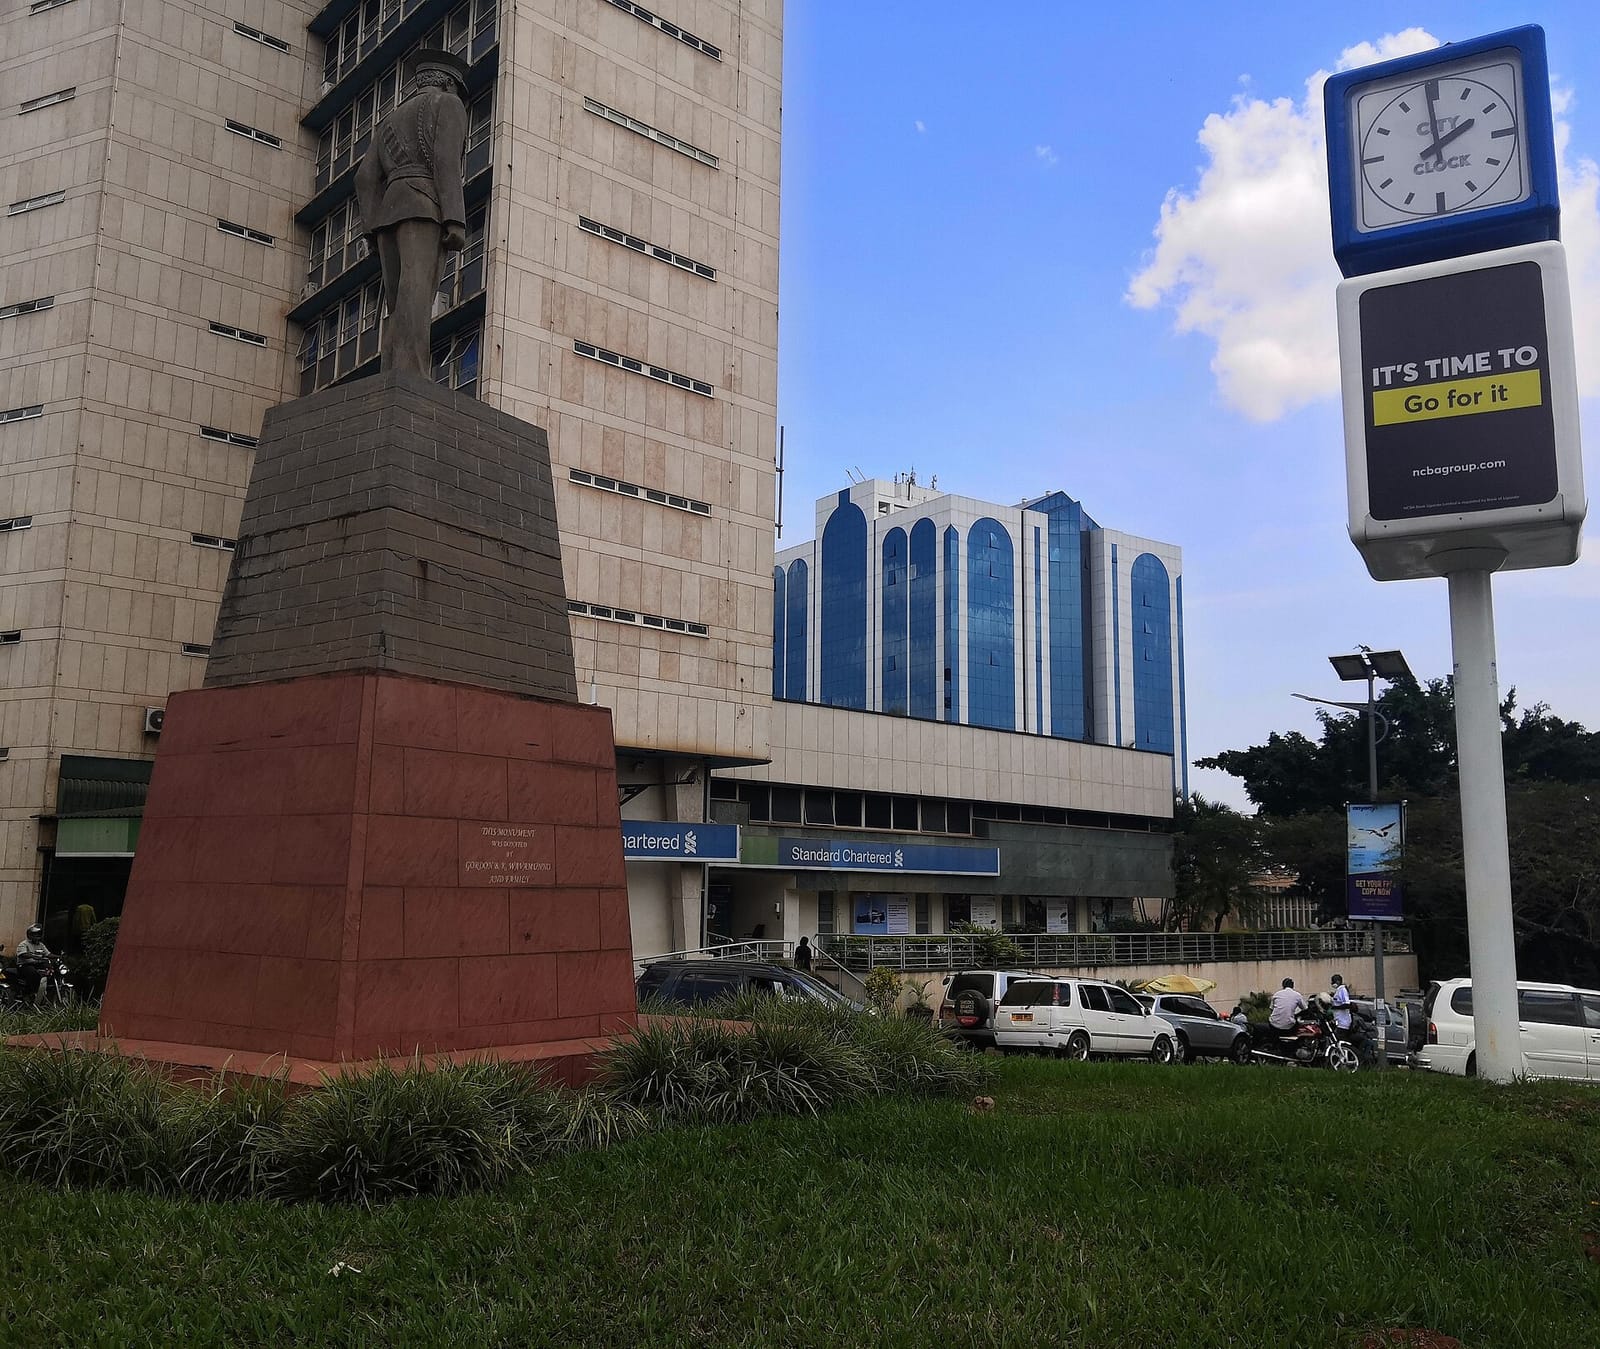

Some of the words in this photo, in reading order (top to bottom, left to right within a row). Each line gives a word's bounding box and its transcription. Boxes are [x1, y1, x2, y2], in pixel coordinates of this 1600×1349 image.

[1416, 115, 1461, 136] CTY
[1413, 154, 1472, 175] CLOCK
[1372, 362, 1419, 387] IT'S
[1424, 351, 1492, 379] TIME
[1498, 345, 1539, 369] TO
[1404, 395, 1439, 414] Go
[1447, 389, 1482, 409] for
[1491, 384, 1508, 403] it
[1411, 459, 1506, 477] ncbagroup.com
[791, 846, 841, 862] Standard
[842, 848, 892, 864] Chartered
